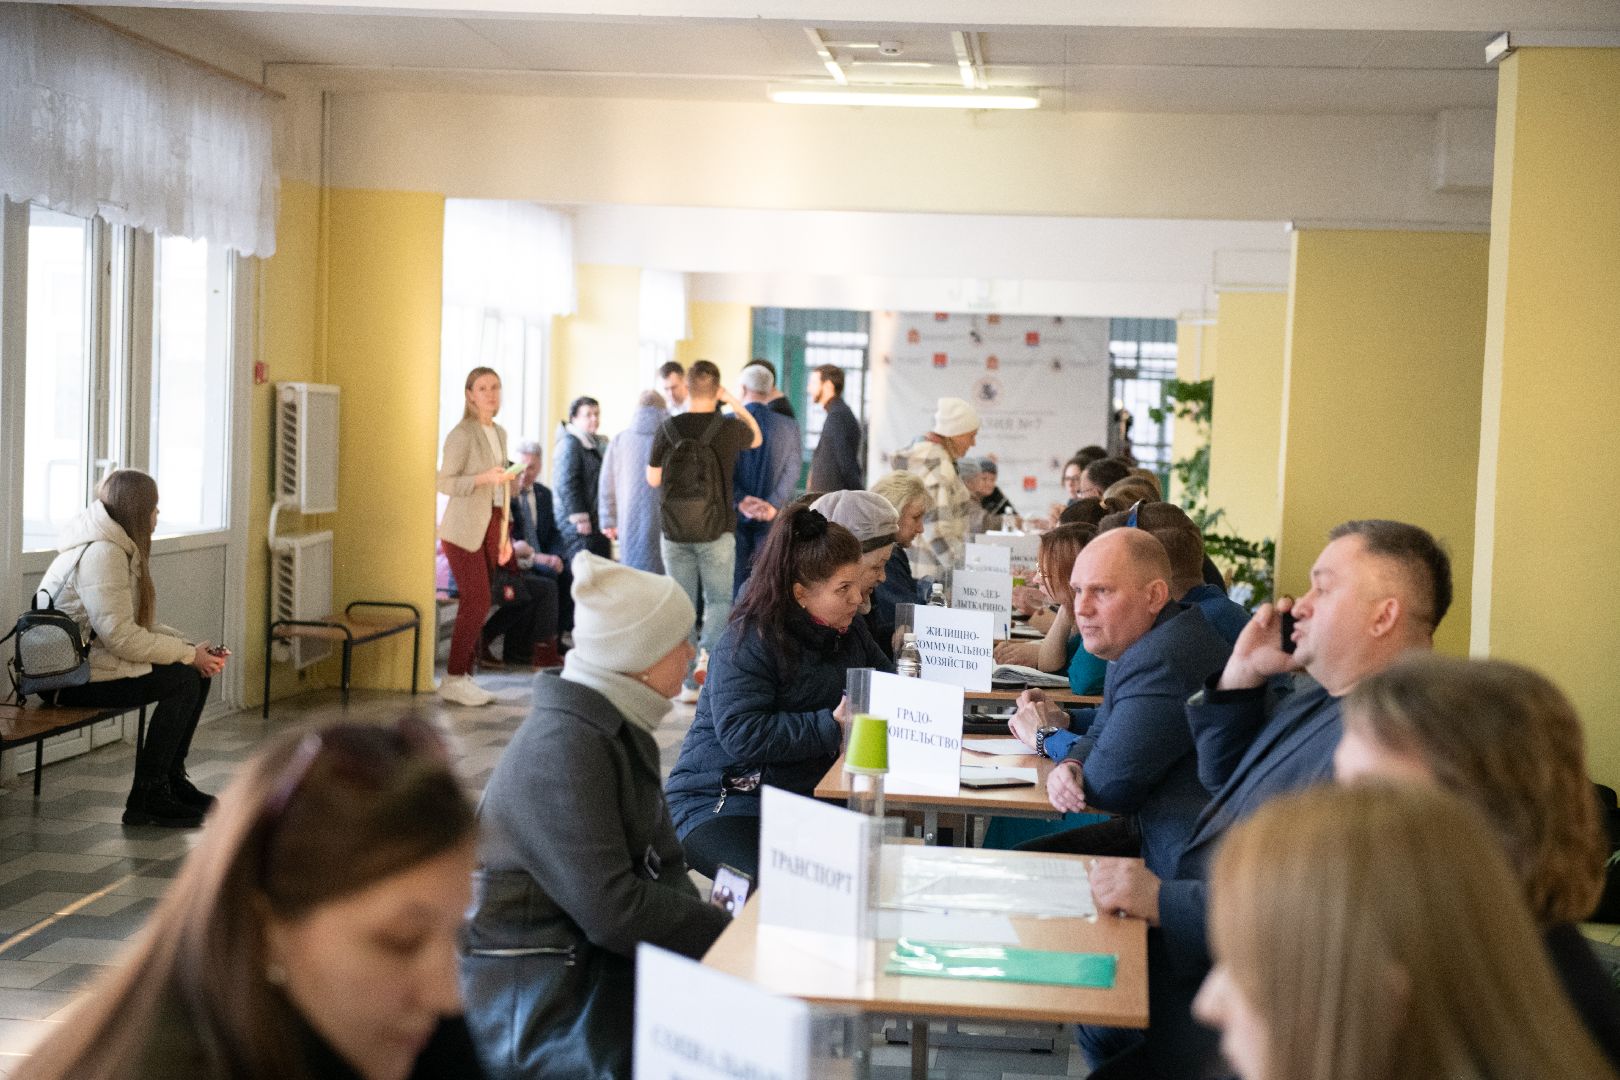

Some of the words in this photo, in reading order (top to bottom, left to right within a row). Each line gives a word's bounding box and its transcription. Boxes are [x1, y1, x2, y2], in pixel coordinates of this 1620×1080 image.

[925, 626, 980, 641] ЖИЛИЩНО-
[925, 655, 978, 670] ХОЗЯЙСТВО
[897, 707, 933, 724] ГРАДО-
[887, 726, 959, 750] ОИТЕЛЬСТВО
[770, 847, 853, 895] ТРАНСПОРТ
